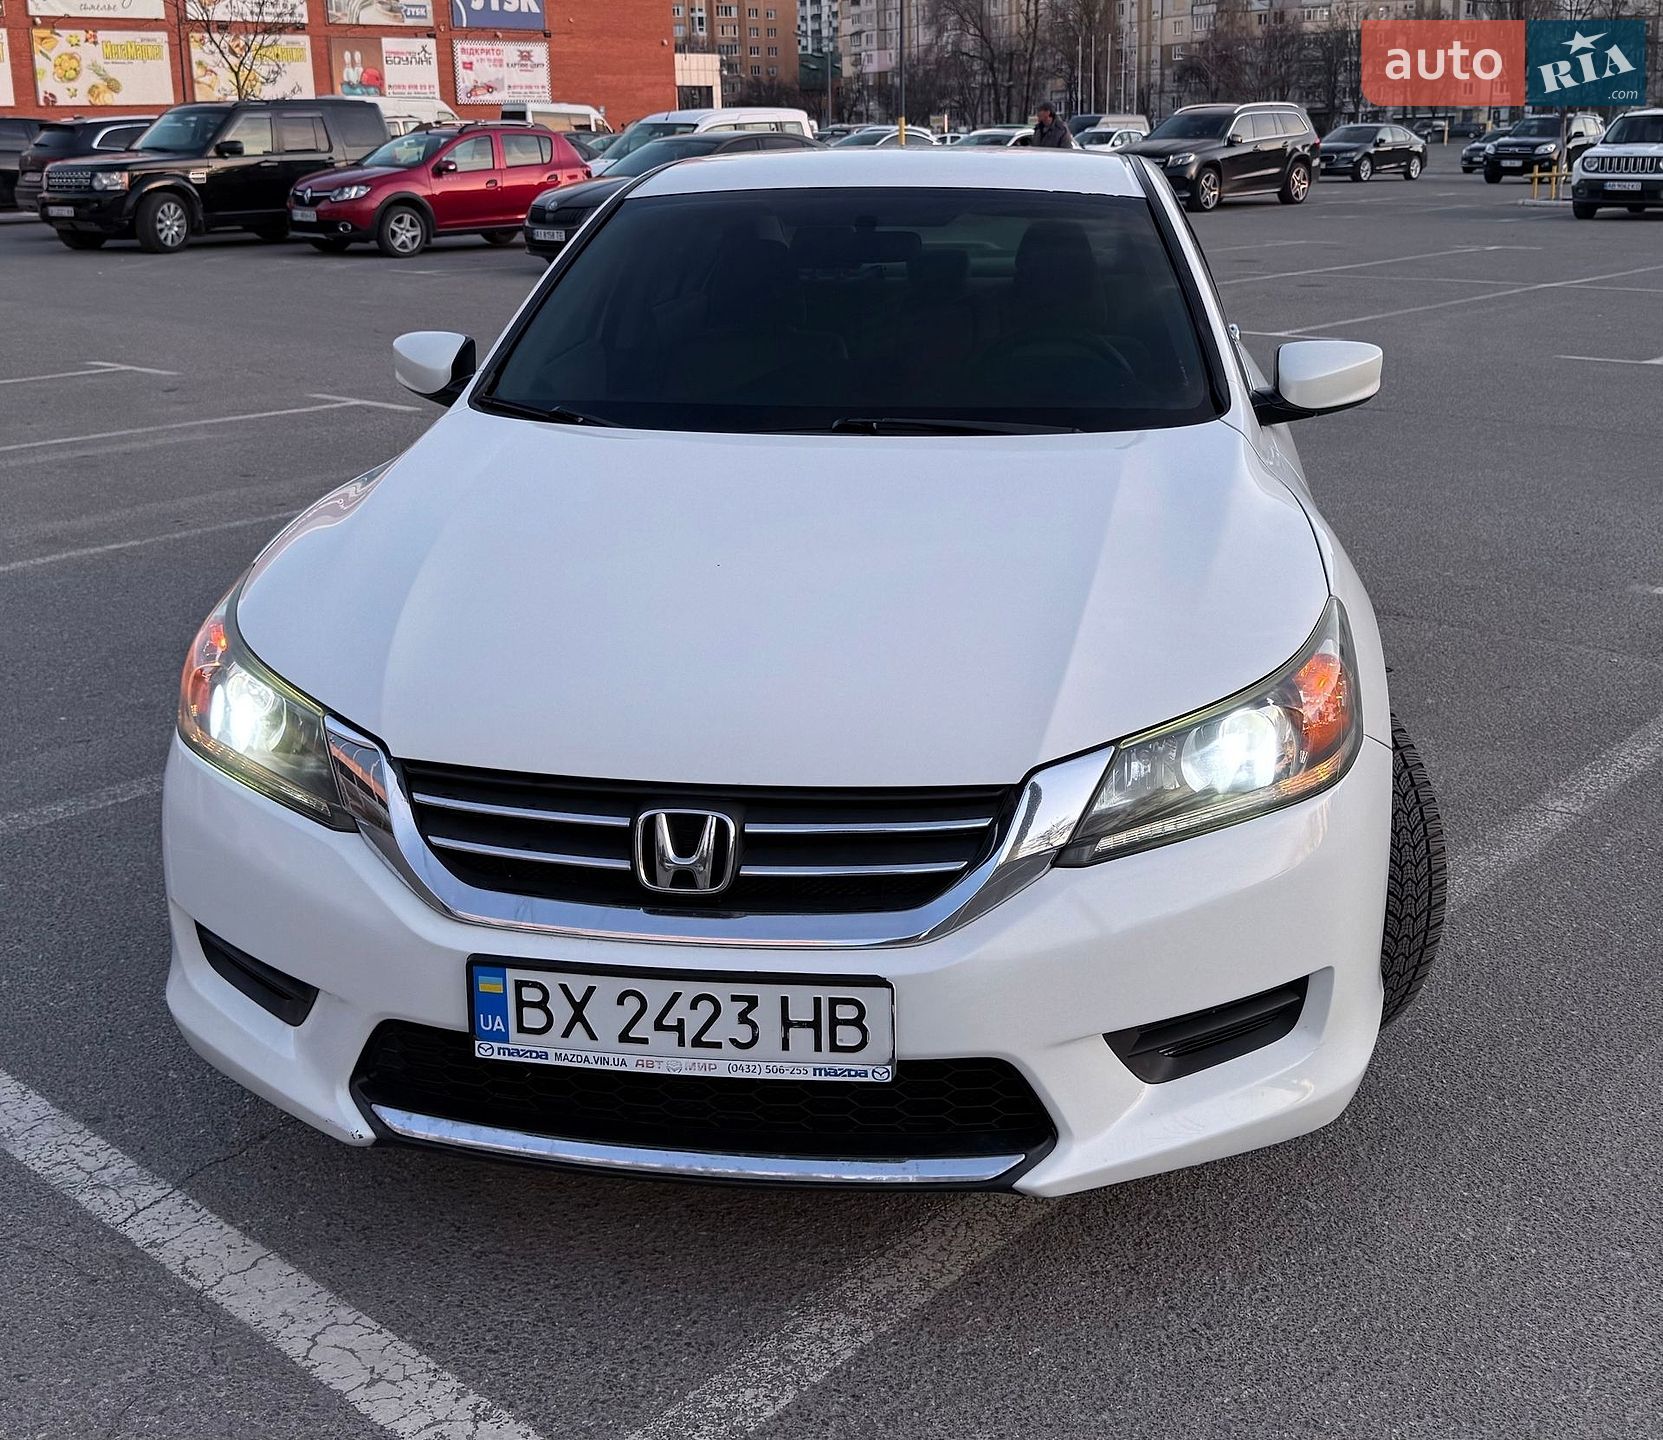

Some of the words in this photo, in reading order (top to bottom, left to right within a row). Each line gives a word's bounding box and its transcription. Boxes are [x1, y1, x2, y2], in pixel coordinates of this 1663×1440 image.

[406, 7, 427, 16] JYSK
[480, 1014, 506, 1033] UA
[514, 979, 598, 1041] BX
[616, 988, 760, 1049] 2423
[780, 994, 870, 1054] HB
[497, 1046, 549, 1061] mazda
[554, 1051, 628, 1068] MAZDA.VIN.UA
[727, 1063, 762, 1076] (0432)
[765, 1064, 809, 1076] 506-255
[812, 1066, 869, 1079] mazda
